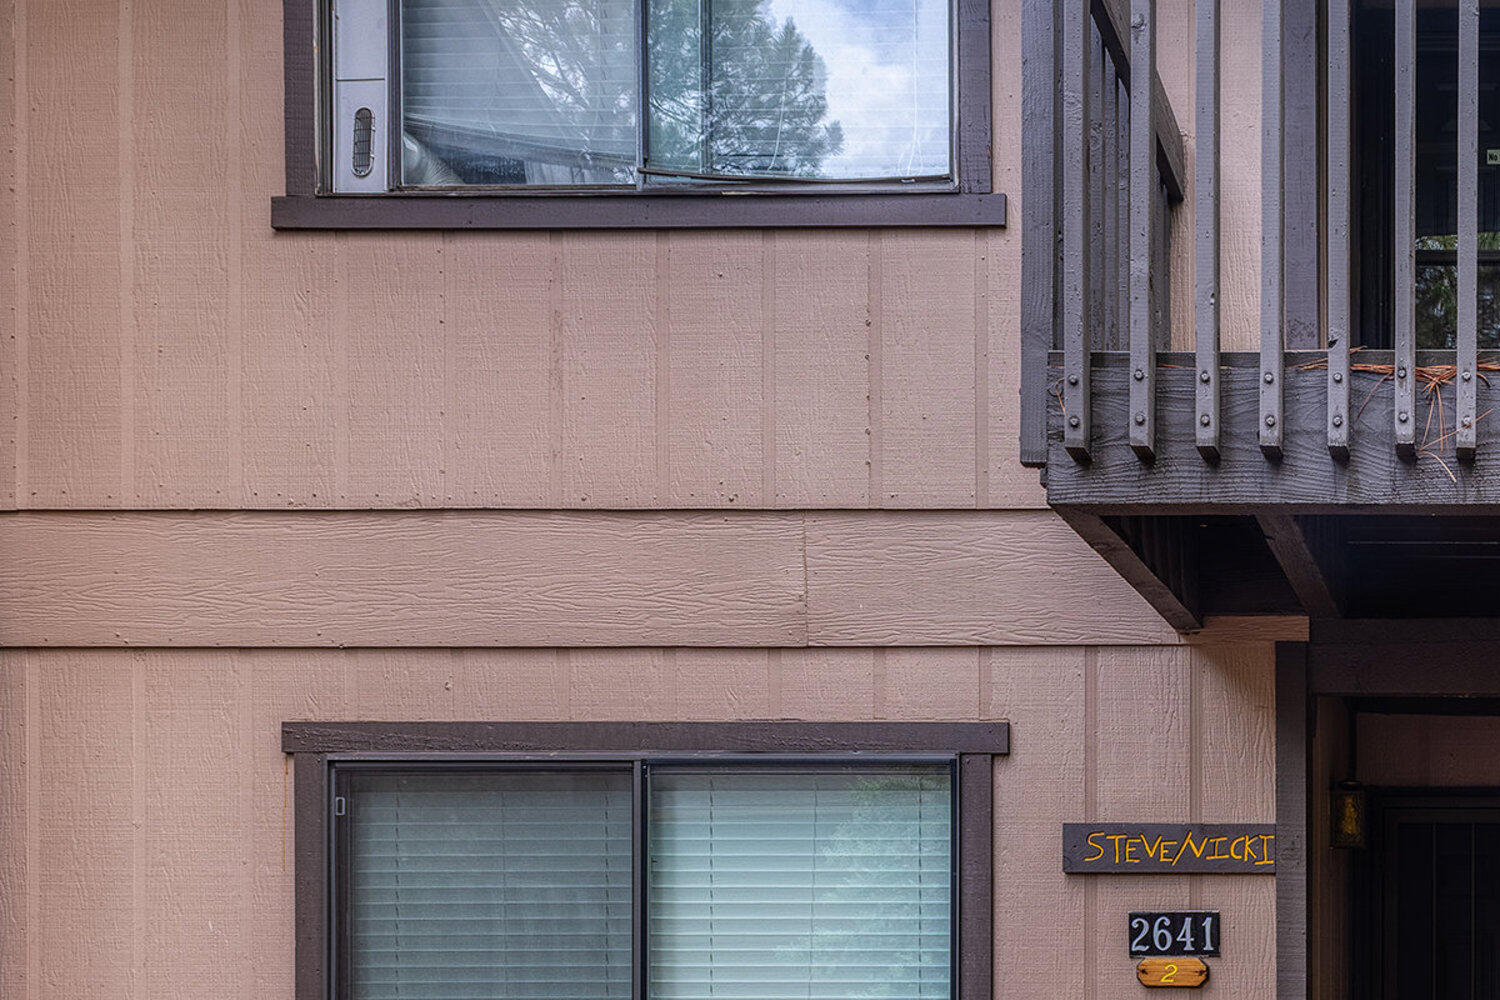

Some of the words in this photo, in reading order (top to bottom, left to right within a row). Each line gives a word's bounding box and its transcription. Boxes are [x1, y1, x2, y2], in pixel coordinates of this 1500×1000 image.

[1488, 153, 1498, 161] No
[1084, 831, 1275, 866] STEVE/NICKI
[1131, 916, 1215, 952] 2641
[1160, 964, 1179, 983] 2
